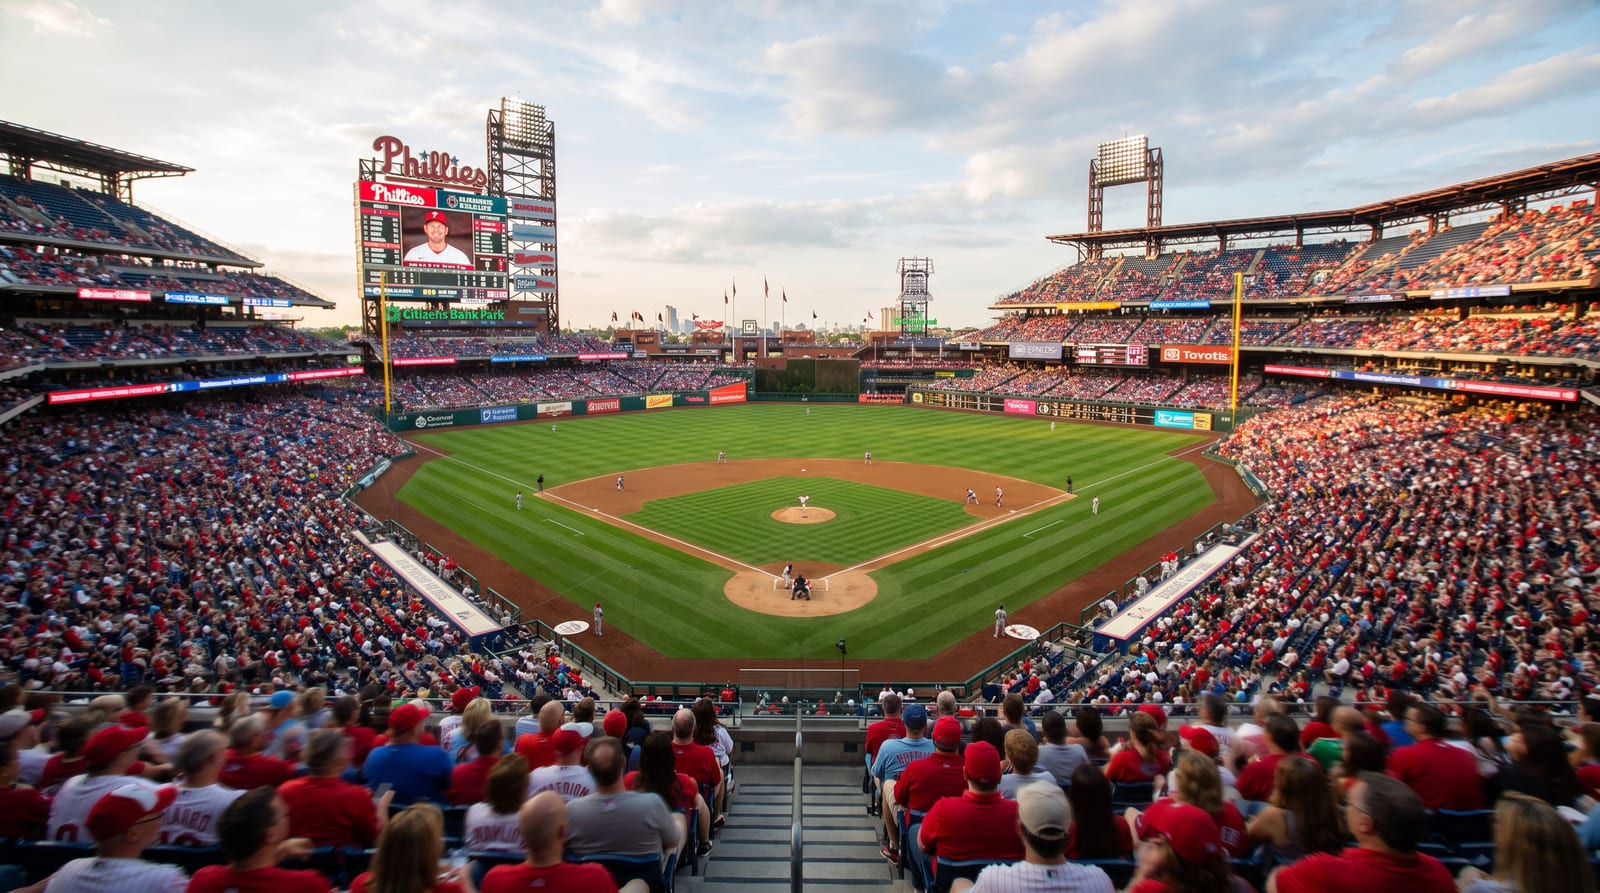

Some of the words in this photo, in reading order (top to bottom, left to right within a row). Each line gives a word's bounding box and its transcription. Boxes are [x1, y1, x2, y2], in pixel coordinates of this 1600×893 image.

[373, 135, 488, 186] Phillies
[371, 184, 424, 205] Phillies
[450, 309, 479, 320] Bank
[480, 309, 504, 320] Park
